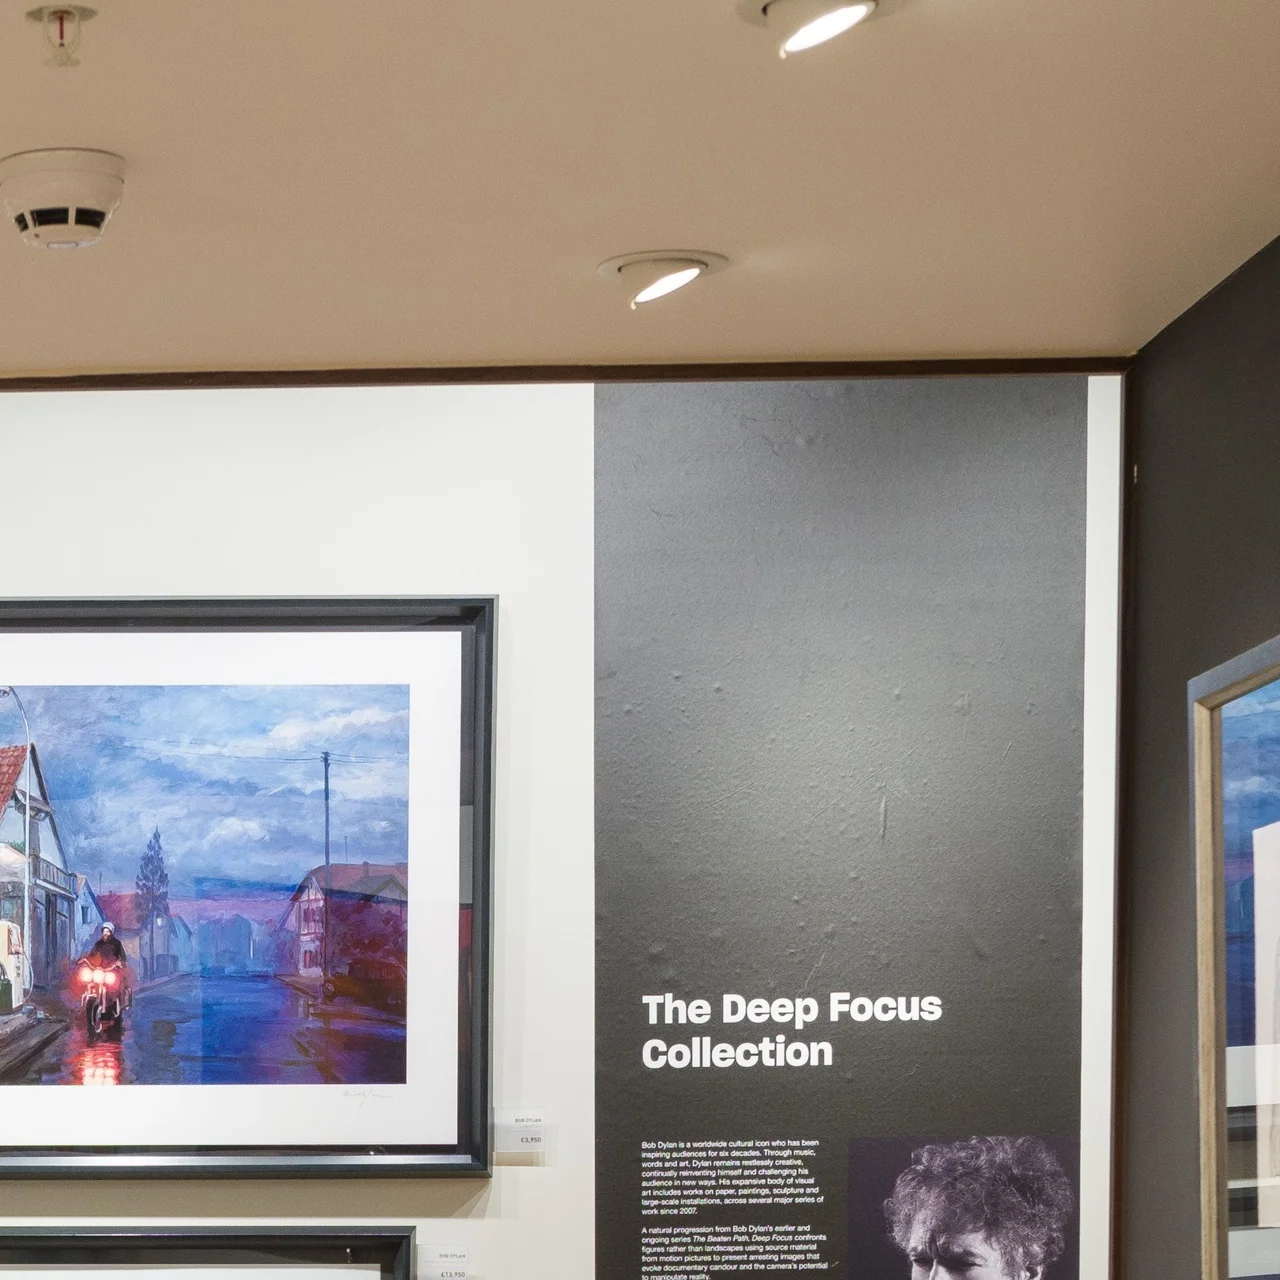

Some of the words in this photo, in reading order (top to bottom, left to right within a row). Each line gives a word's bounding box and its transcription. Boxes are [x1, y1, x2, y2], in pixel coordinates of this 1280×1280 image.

[642, 993, 711, 1025] The
[723, 994, 819, 1030] Deep
[830, 992, 942, 1022] Focus
[642, 1035, 832, 1069] Collection
[641, 1141, 656, 1149] Bob
[657, 1141, 677, 1150] Dylan
[692, 1140, 727, 1148] worldwide
[728, 1140, 754, 1148] cultural
[787, 1139, 800, 1147] has
[801, 1139, 819, 1147] been
[641, 1150, 671, 1160] inspiring
[672, 1150, 707, 1158] audiences
[763, 1149, 792, 1159] Through
[642, 1160, 663, 1168] words
[692, 1159, 712, 1169] Dylan
[713, 1159, 741, 1167] remains
[741, 1159, 774, 1168] restlessly
[641, 1169, 678, 1179] continually
[679, 1169, 716, 1178] reinventing
[743, 1168, 757, 1176] and
[758, 1168, 797, 1178] challenging
[718, 1178, 731, 1186] His
[731, 1178, 766, 1187] expansive
[767, 1178, 785, 1187] body
[795, 1177, 815, 1185] visual
[652, 1188, 681, 1196] includes
[683, 1188, 703, 1196] works
[772, 1187, 804, 1196] sculpture
[773, 1198, 793, 1206] major
[794, 1196, 815, 1204] series
[641, 1207, 659, 1215] work
[660, 1207, 679, 1215] since
[648, 1226, 672, 1234] natural
[673, 1226, 714, 1235] progression
[774, 1225, 796, 1233] earlier
[641, 1236, 670, 1245] ongoing
[693, 1235, 706, 1243] The
[707, 1235, 732, 1243] Beaten
[751, 1235, 771, 1244] Deep
[794, 1234, 827, 1242] confronts
[641, 1245, 665, 1255] figures
[666, 1245, 686, 1253] rather
[688, 1245, 704, 1253] than
[704, 1245, 744, 1254] landscapes
[744, 1244, 764, 1254] using
[641, 1255, 658, 1263] from
[684, 1254, 712, 1264] pictures
[721, 1254, 748, 1263] present
[749, 1254, 779, 1263] arresting
[780, 1253, 805, 1263] images
[806, 1253, 820, 1261] that
[641, 1264, 662, 1272] evoke
[663, 1264, 708, 1273] documentary
[739, 1263, 753, 1271] and
[753, 1263, 765, 1271] the
[798, 1263, 828, 1272] potential
